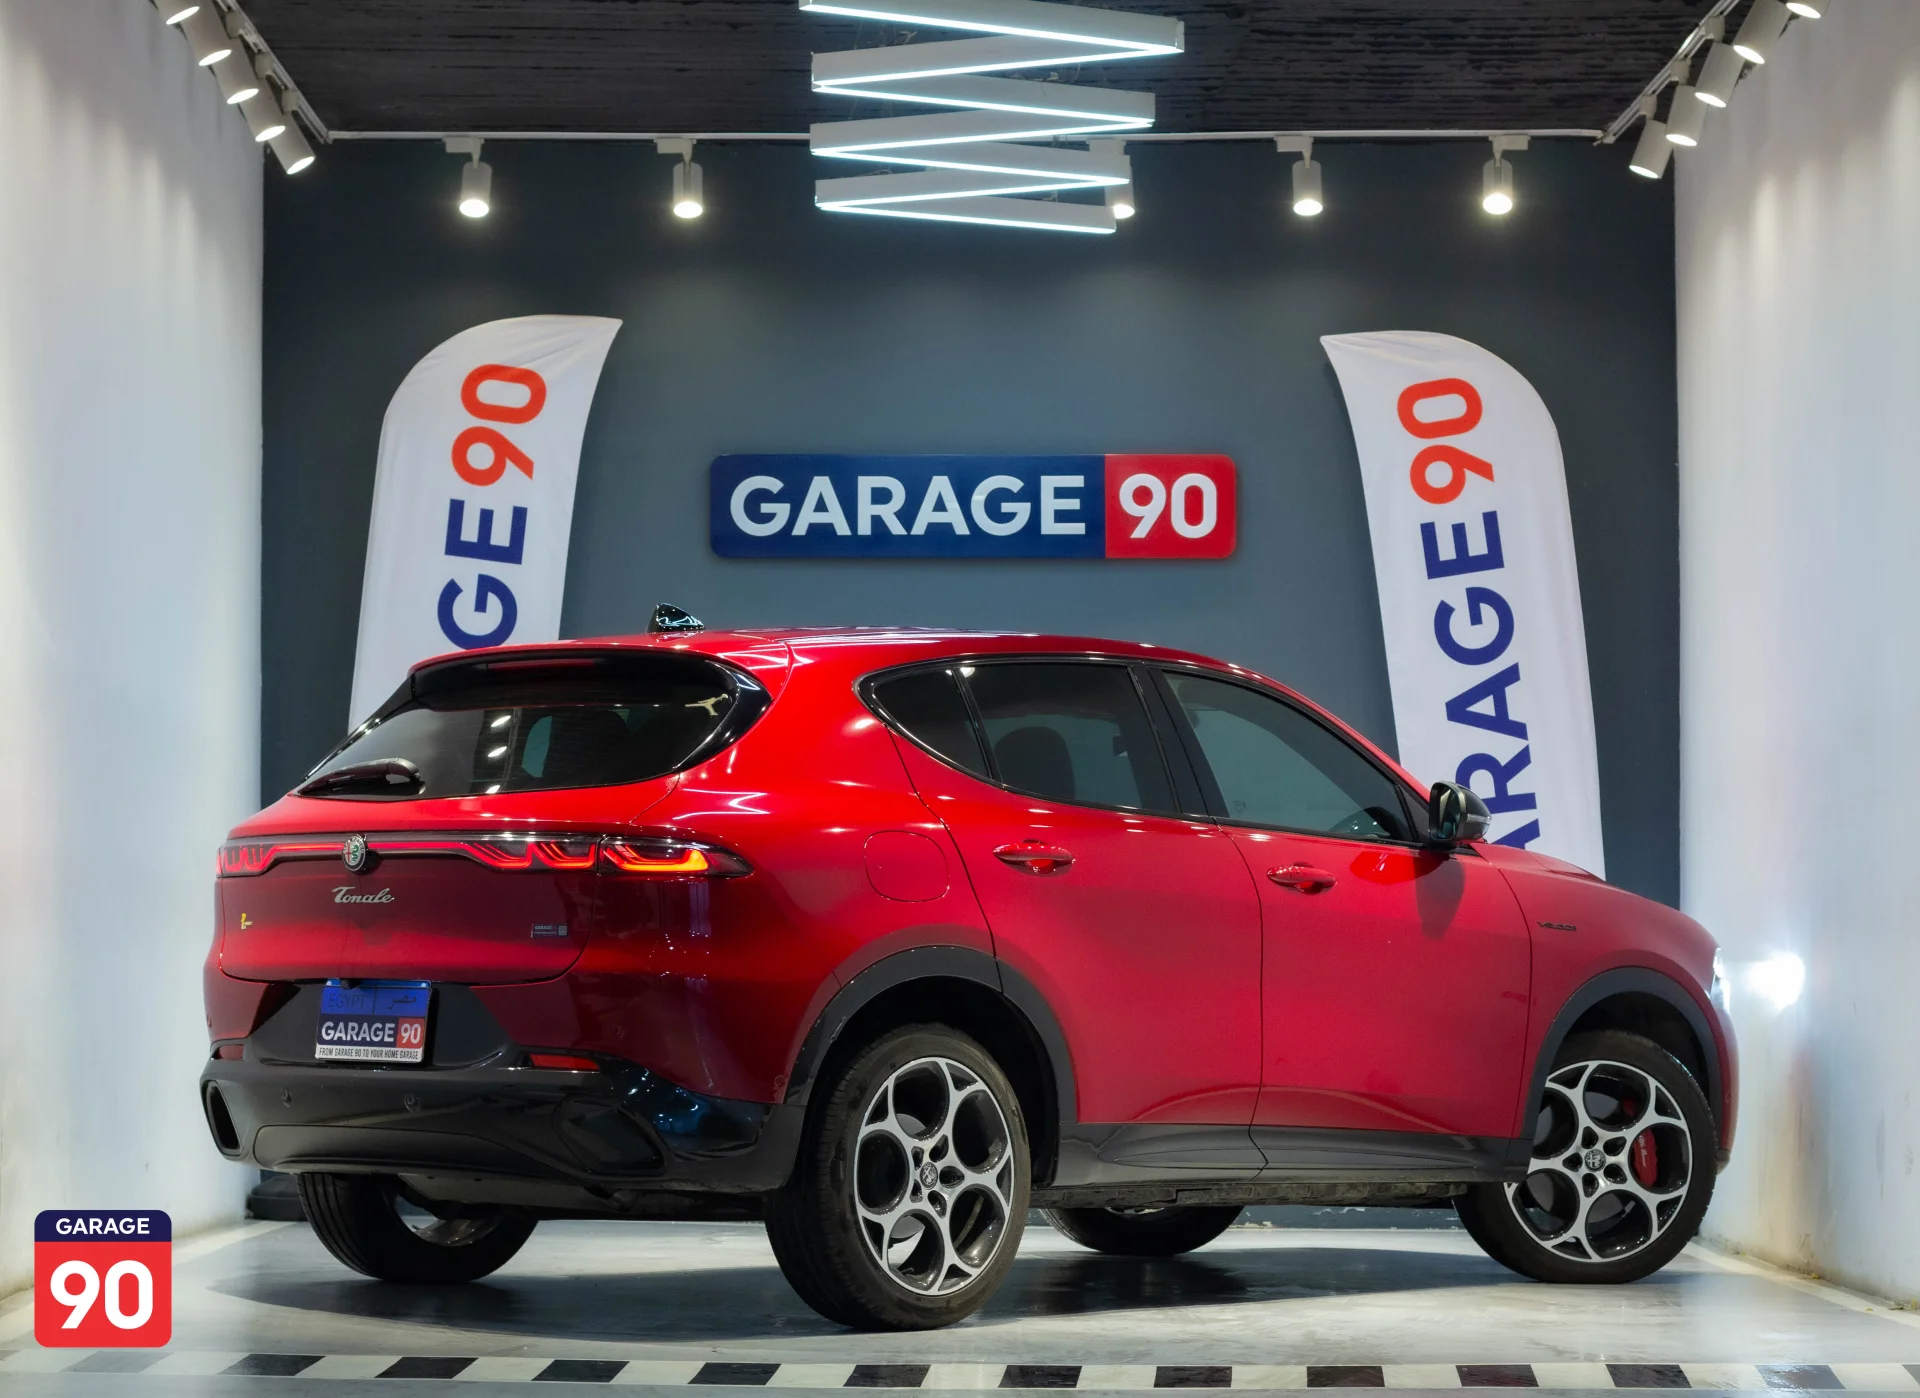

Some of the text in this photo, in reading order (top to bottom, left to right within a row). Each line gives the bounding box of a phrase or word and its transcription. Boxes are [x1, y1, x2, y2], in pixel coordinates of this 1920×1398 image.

[730, 473, 1218, 539] GARAGE 90
[332, 886, 395, 903] Tonale
[328, 993, 367, 1009] EGYPT
[321, 1021, 422, 1044] GARAGE 90
[319, 1047, 419, 1060] FROM GARAGE 90 TO YOUR HOME GARAGE
